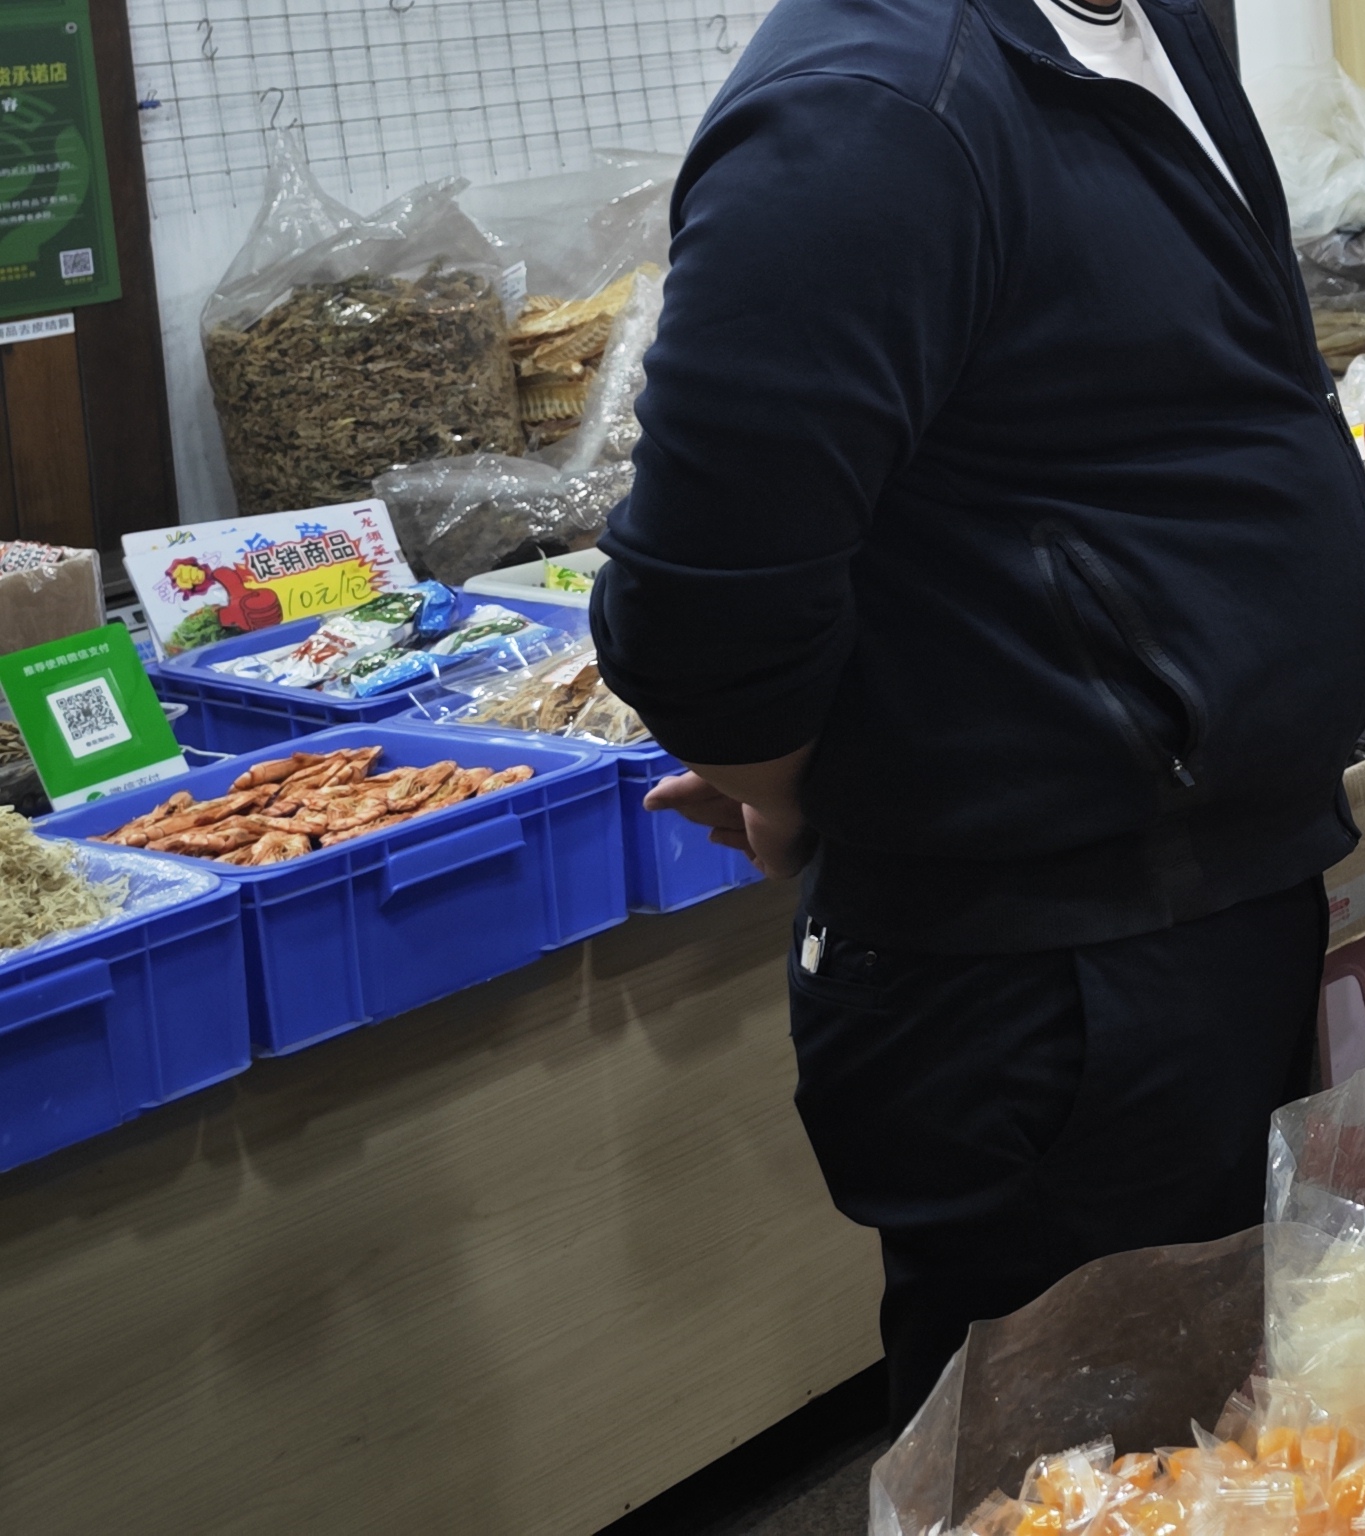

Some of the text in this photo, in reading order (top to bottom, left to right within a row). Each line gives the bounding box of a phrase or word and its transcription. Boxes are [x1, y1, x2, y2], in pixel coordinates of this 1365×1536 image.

[0, 318, 71, 339] 品去皮结算
[250, 532, 356, 581] 促销商品
[23, 642, 110, 677] 推荐使用微信支付
